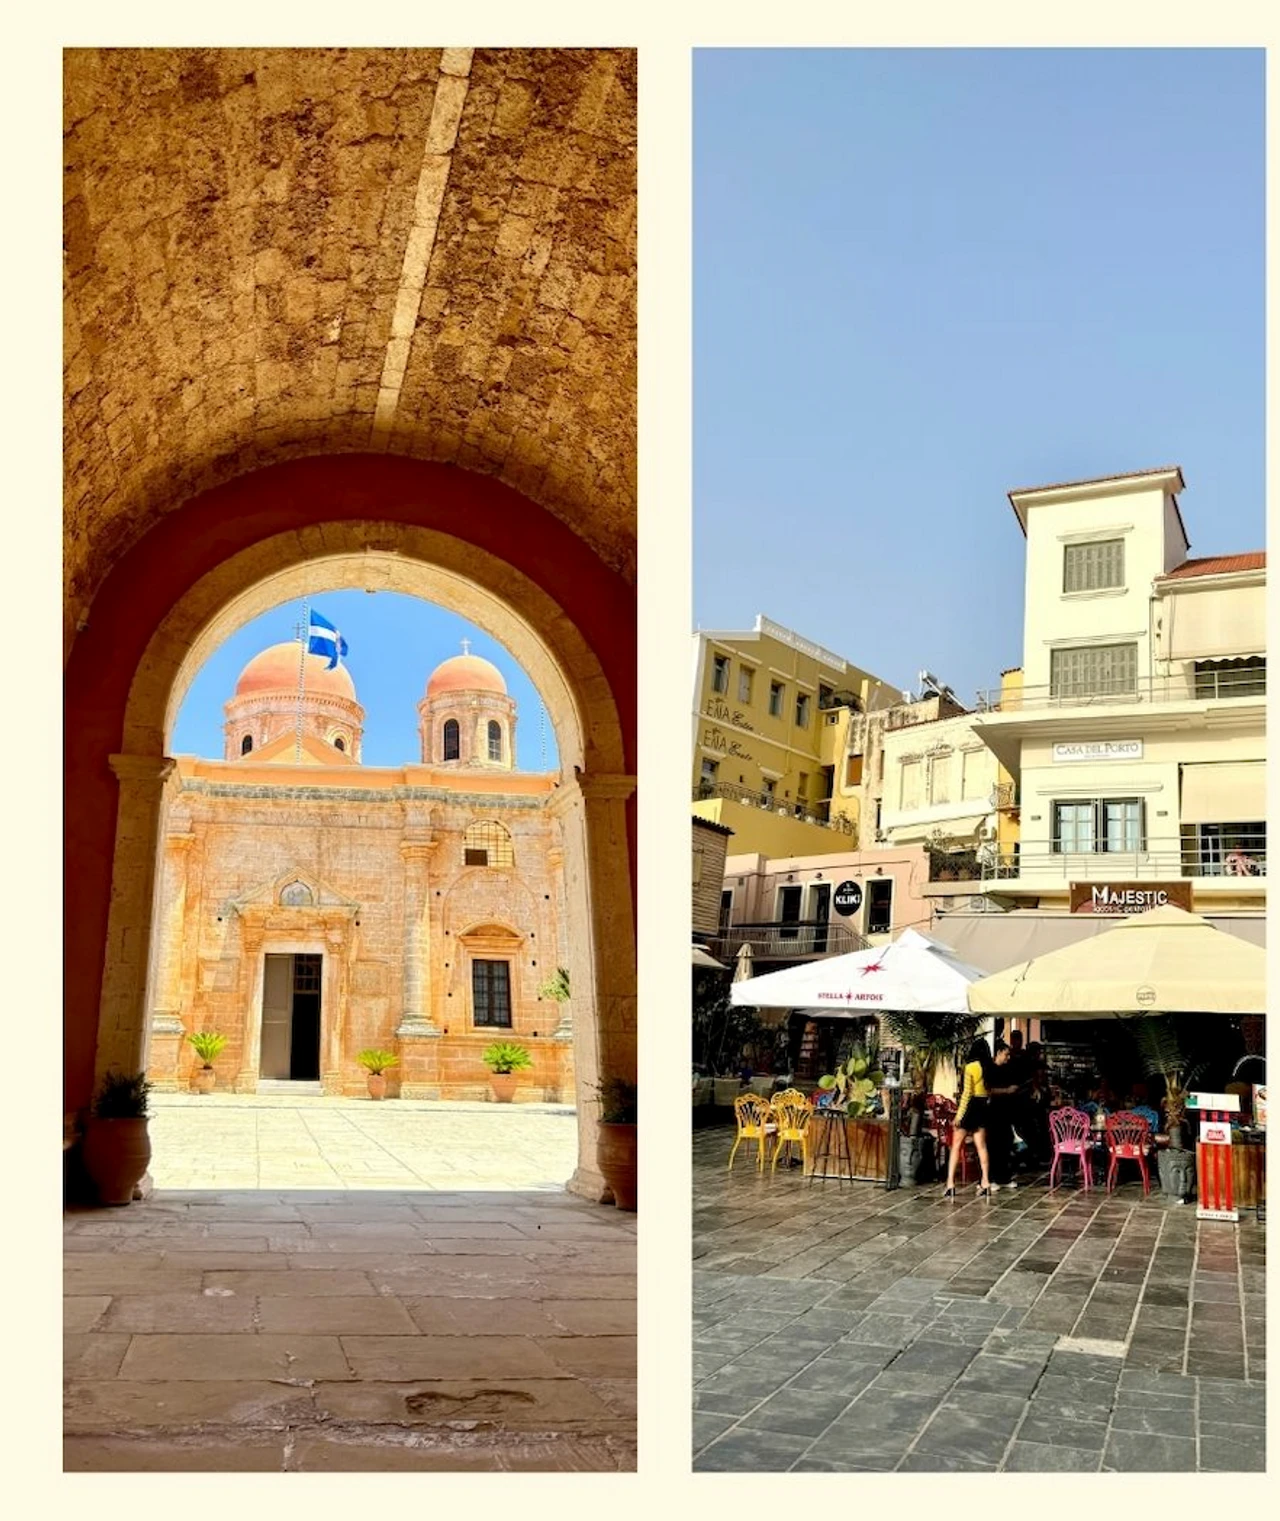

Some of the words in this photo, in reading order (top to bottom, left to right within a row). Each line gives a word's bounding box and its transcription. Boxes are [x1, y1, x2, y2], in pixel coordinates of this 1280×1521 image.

[1056, 744, 1083, 756] CASA
[1104, 742, 1139, 754] PORTO
[1092, 886, 1168, 905] MAJESTIC
